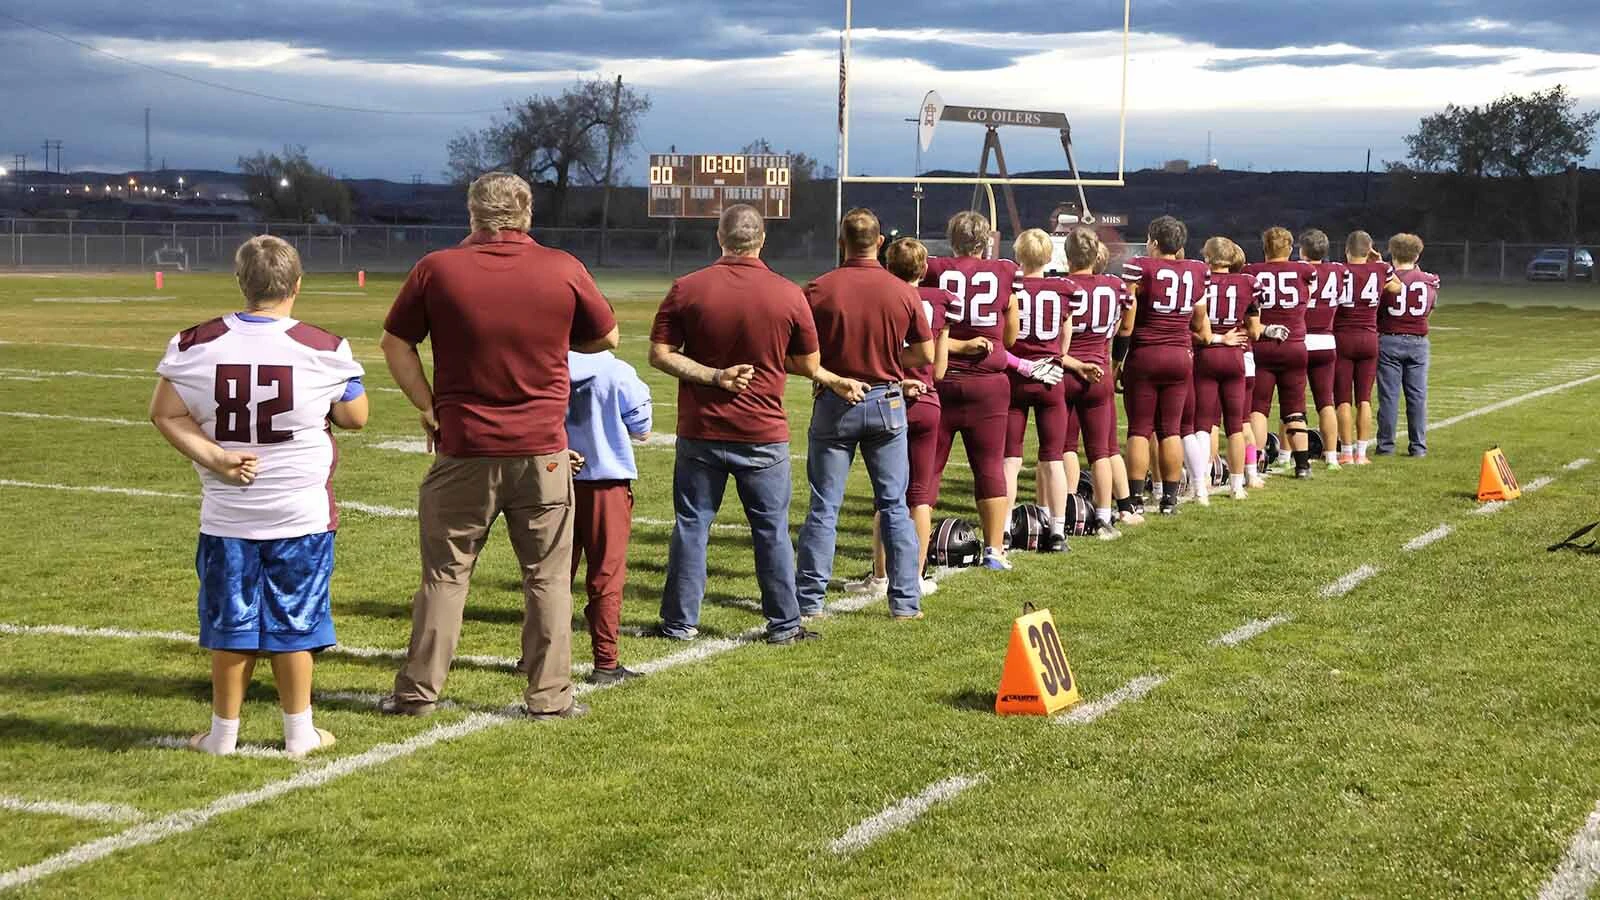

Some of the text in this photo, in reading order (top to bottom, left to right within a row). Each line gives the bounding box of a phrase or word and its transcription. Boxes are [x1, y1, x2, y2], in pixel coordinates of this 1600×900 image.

[967, 110, 1041, 124] GO OILERS
[650, 166, 673, 184] 00
[701, 155, 745, 174] 10:00
[766, 167, 789, 185] 00
[778, 199, 783, 217] 1
[1101, 216, 1121, 225] MHS
[1152, 269, 1193, 314] 31
[1207, 284, 1237, 325] 11
[1387, 281, 1428, 317] 33
[1071, 286, 1116, 334] 20
[214, 363, 295, 444] 82
[1492, 454, 1518, 491] 40
[1028, 621, 1072, 697] 30
